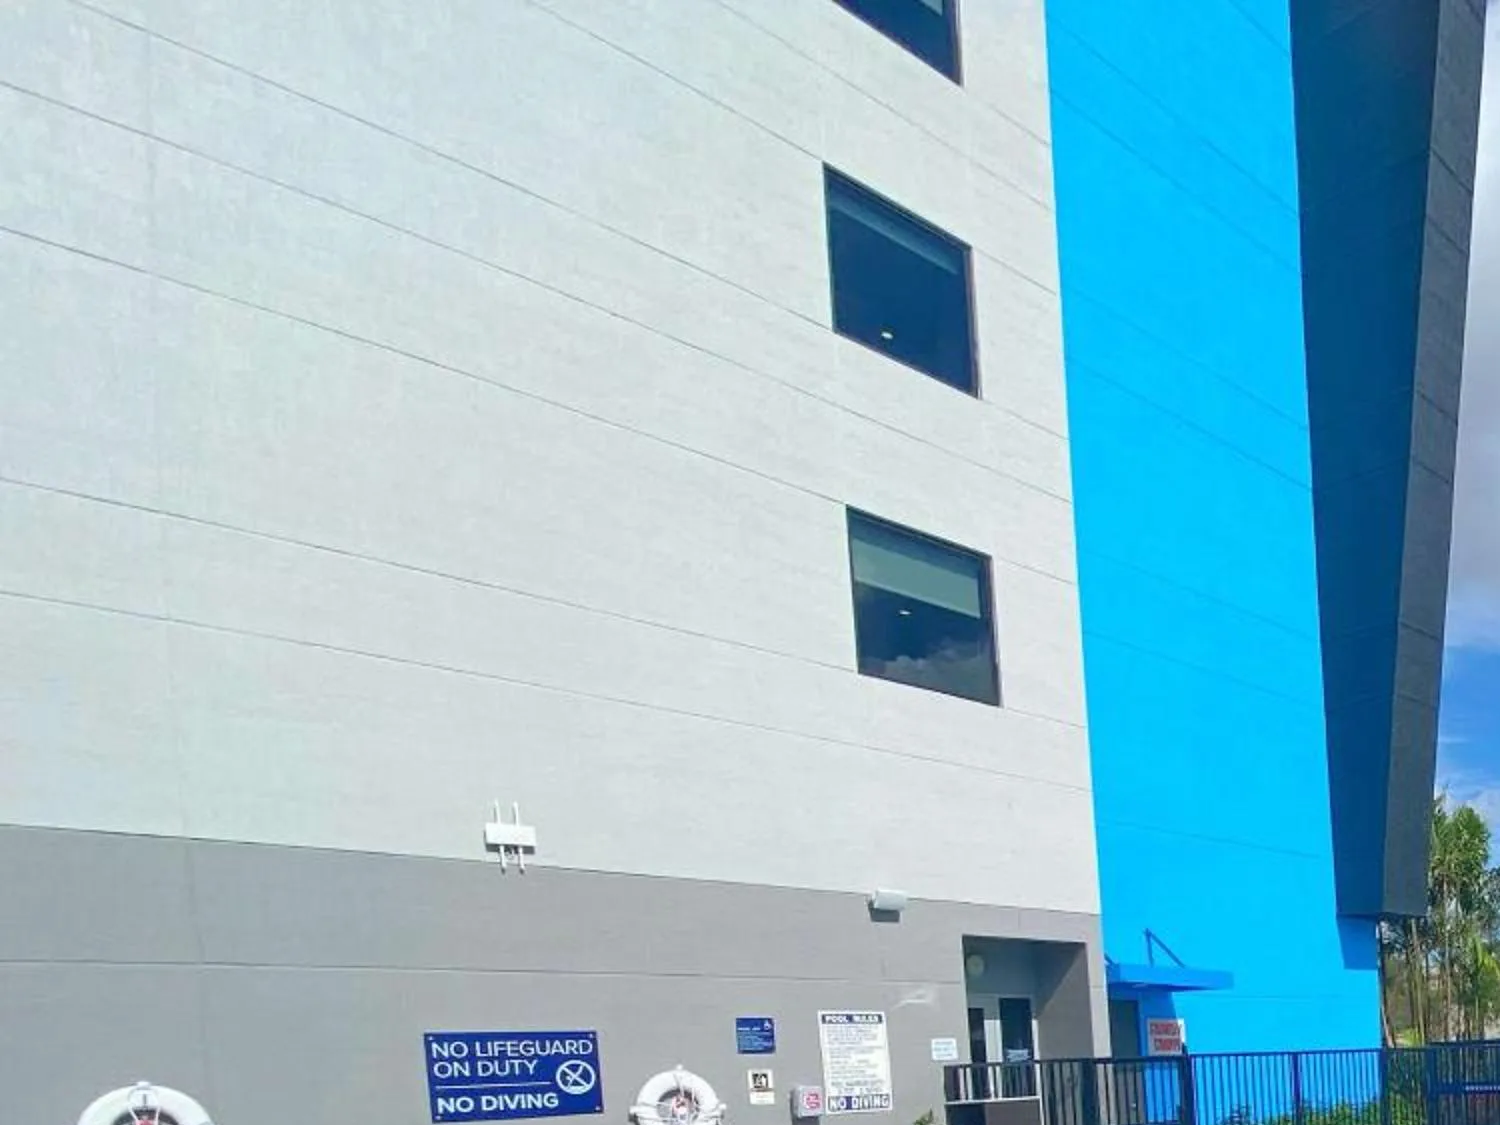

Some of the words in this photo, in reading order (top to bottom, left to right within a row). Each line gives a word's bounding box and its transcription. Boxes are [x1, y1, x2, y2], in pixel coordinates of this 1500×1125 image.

[431, 1041, 468, 1058] NO
[475, 1039, 593, 1058] LIFEGUARD
[433, 1061, 471, 1078] ON
[477, 1059, 538, 1077] DUTY
[437, 1097, 474, 1114] NO
[481, 1092, 559, 1112] DIVING
[829, 1096, 847, 1111] NO
[851, 1094, 889, 1109] DIVING
